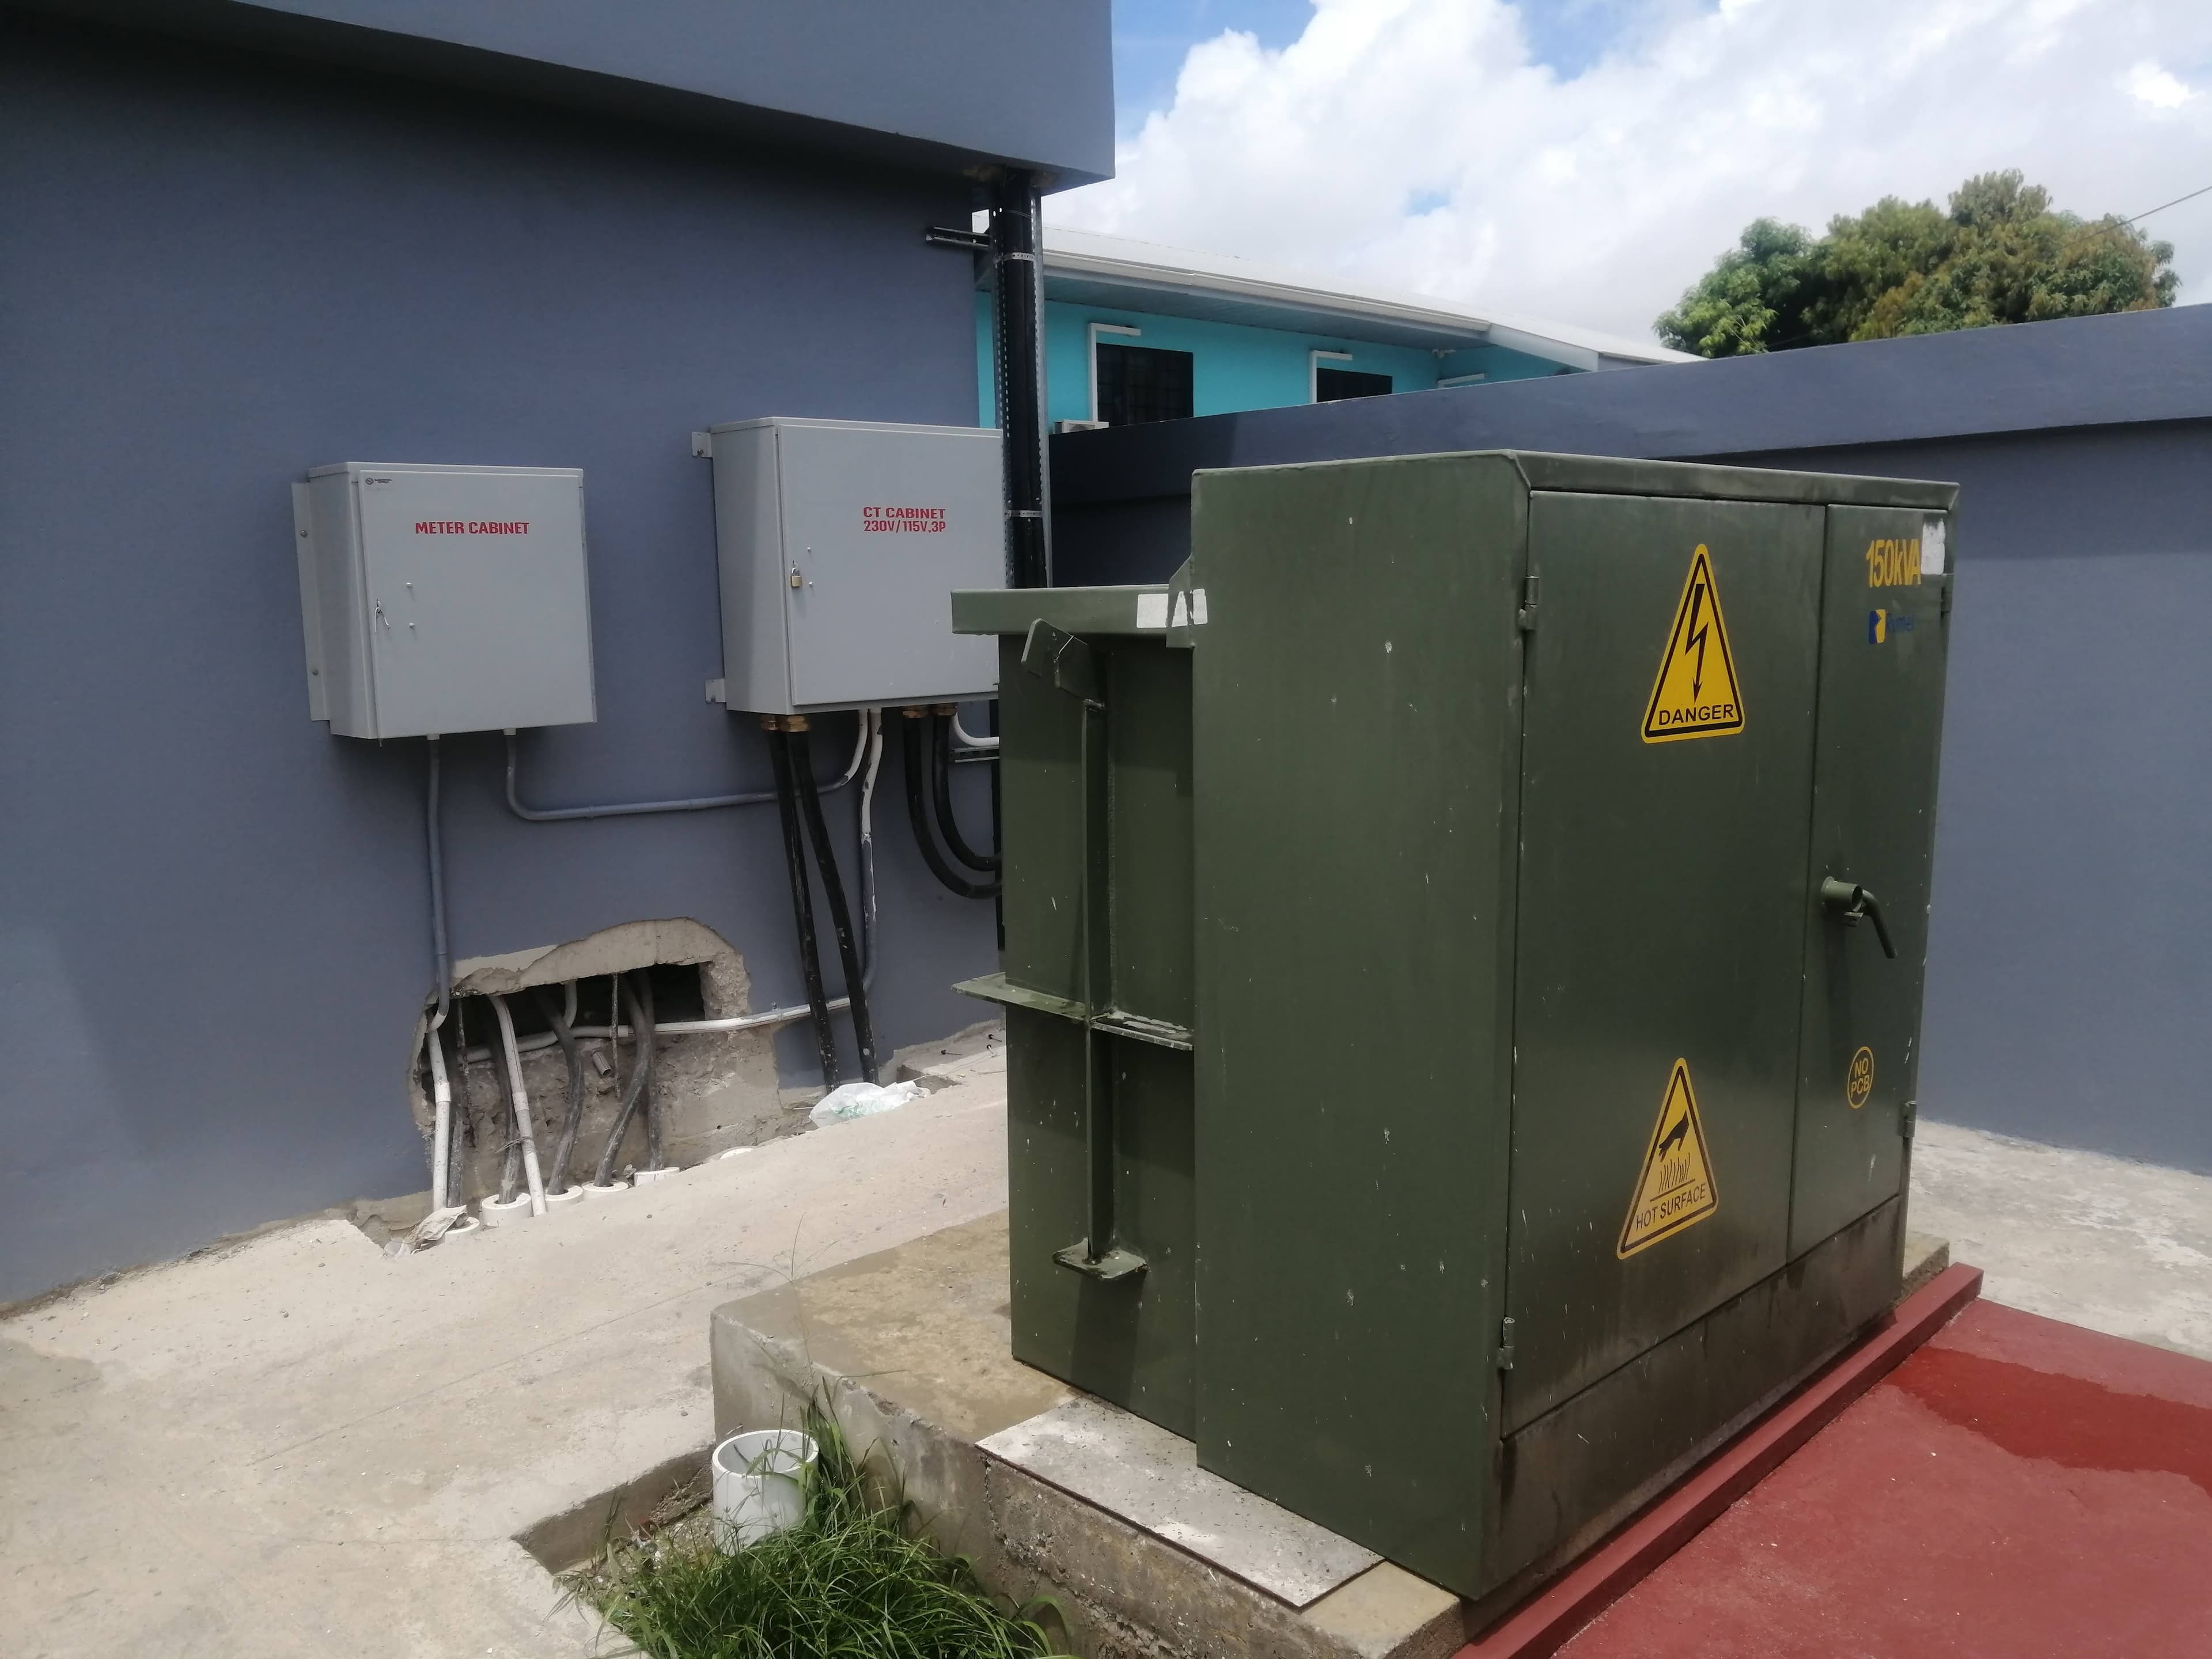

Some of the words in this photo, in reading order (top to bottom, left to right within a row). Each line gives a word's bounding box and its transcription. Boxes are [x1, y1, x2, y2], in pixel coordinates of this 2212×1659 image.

[863, 506, 881, 518] CT
[886, 507, 945, 519] CABINET
[415, 522, 464, 534] METER
[468, 522, 529, 535] CABINET
[863, 520, 946, 533] 230V/115V,3P
[1866, 539, 1922, 588] 150kVA
[1659, 704, 1734, 725] DANGER
[1855, 1058, 1869, 1079] NO
[1851, 1075, 1870, 1099] PCB
[1636, 1206, 1658, 1231] HOT
[1660, 1183, 1706, 1219] SURFACE
